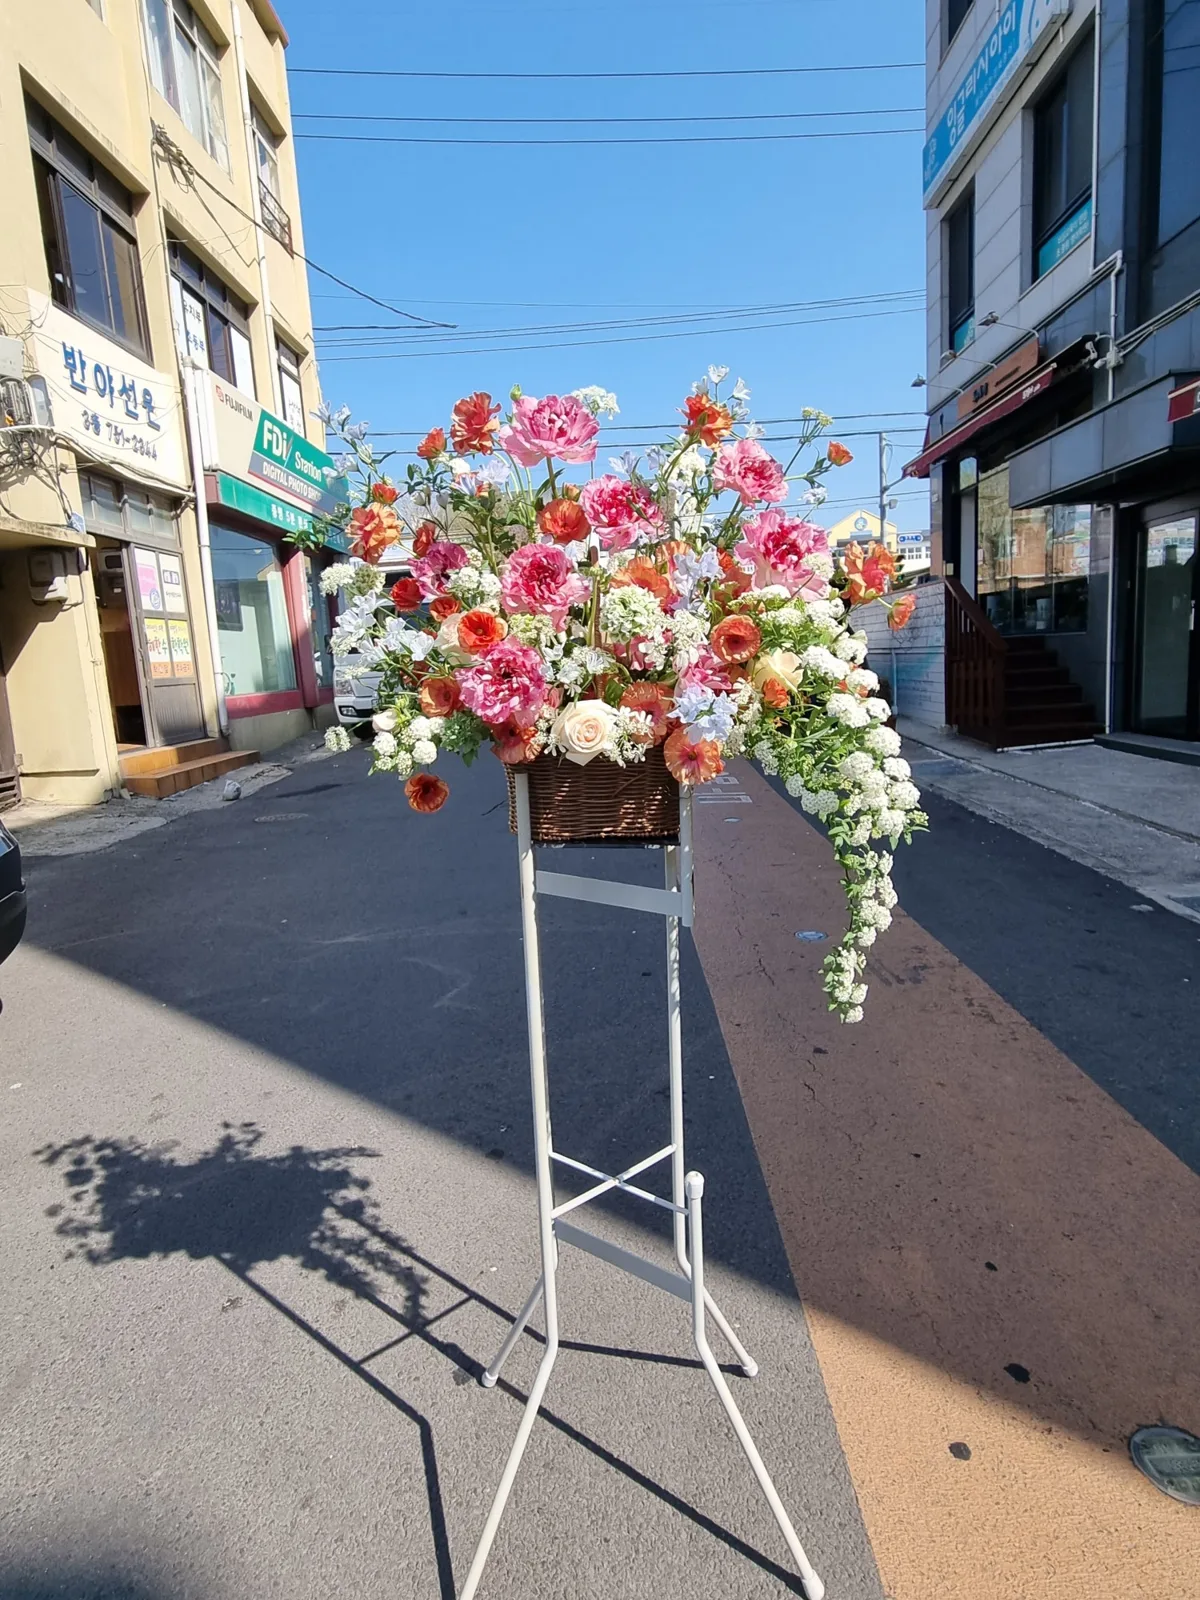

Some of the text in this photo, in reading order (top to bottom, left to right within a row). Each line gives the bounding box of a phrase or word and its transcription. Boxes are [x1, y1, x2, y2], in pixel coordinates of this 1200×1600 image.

[224, 393, 254, 422] FUJIFILM
[262, 461, 288, 486] DIGITAL
[288, 475, 308, 497] PHOTO
